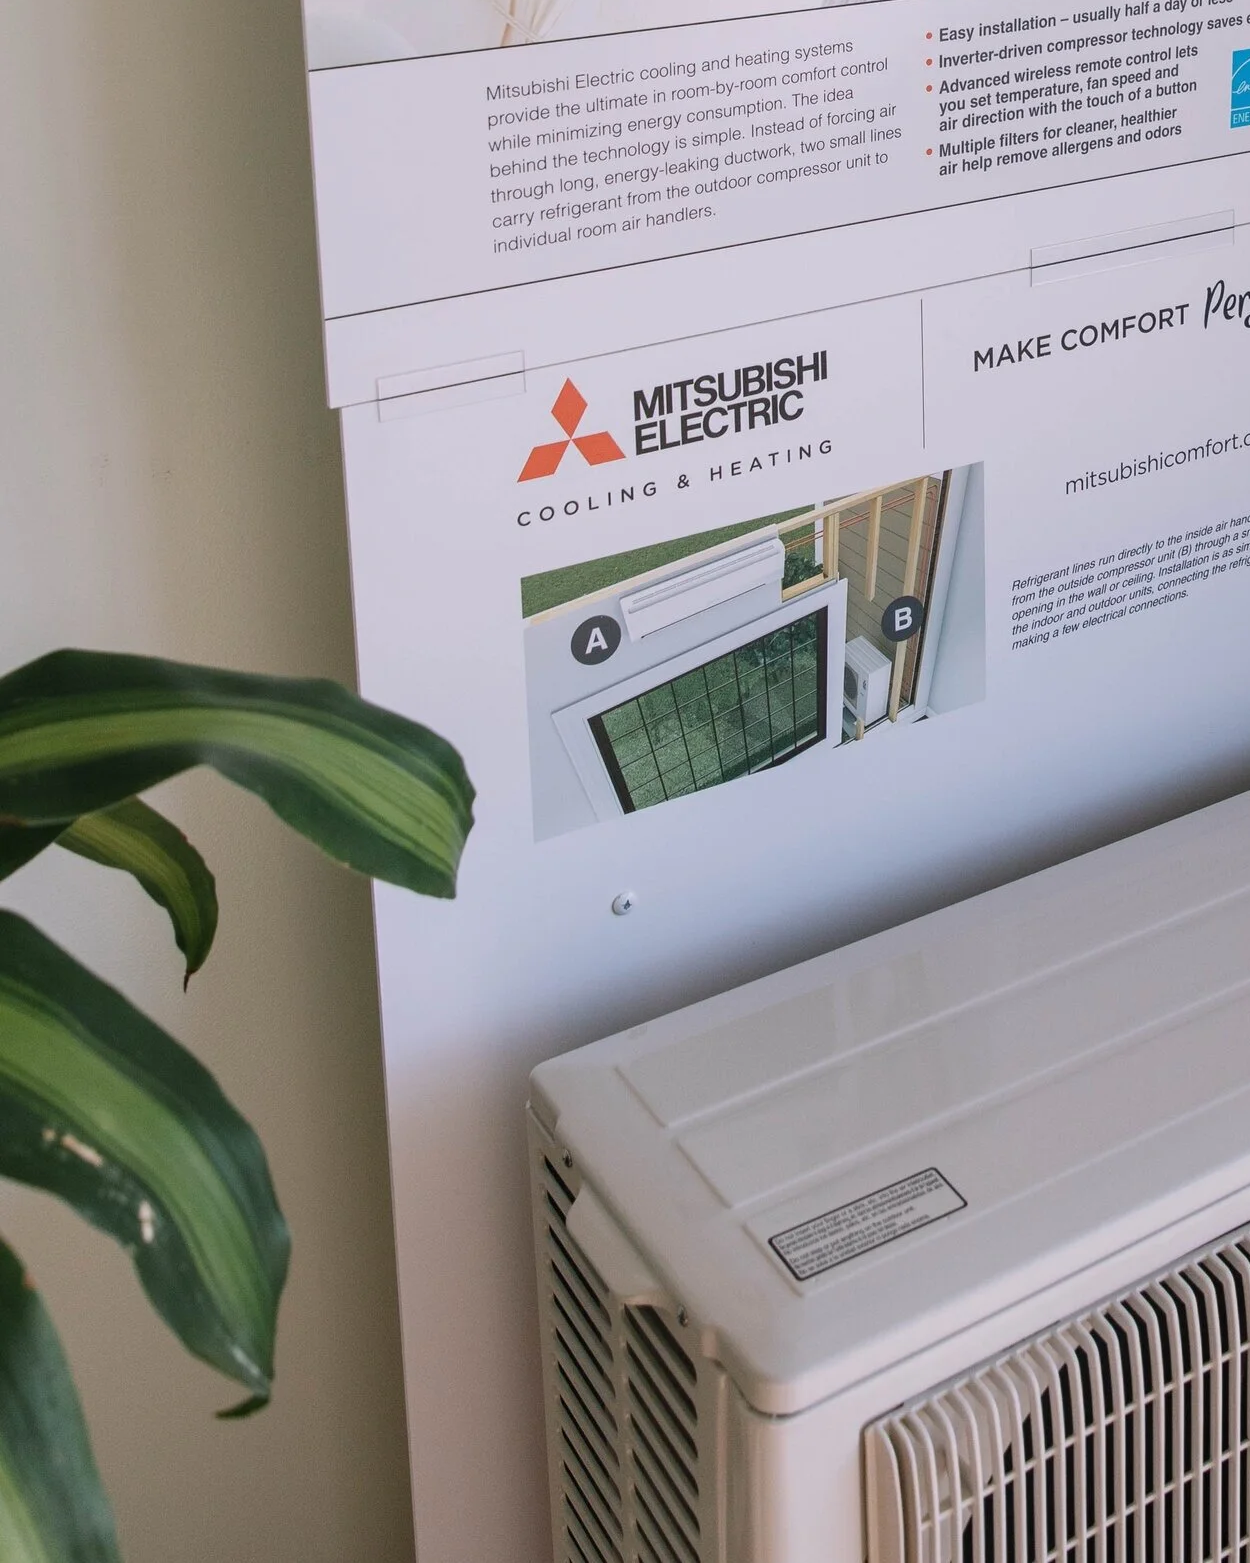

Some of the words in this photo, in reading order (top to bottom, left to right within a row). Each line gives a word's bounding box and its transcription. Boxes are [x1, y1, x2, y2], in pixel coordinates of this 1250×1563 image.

[939, 27, 975, 42] Easy
[979, 15, 1057, 37] installation
[1073, 5, 1121, 24] usually
[1125, 0, 1150, 17] half
[1152, 2, 1161, 13] a
[939, 44, 1043, 69] Inverter-driven
[1047, 31, 1128, 53] compressor
[1131, 21, 1204, 41] technology
[1207, 15, 1243, 30] saves
[486, 76, 570, 101] Mitsubishi
[575, 68, 635, 90] Electric
[639, 61, 696, 81] cooling
[701, 54, 730, 73] and
[735, 49, 790, 68] heating
[794, 39, 854, 62] systems
[939, 70, 1010, 95] Advanced
[1014, 65, 1072, 83] wireless
[1075, 56, 1122, 74] remote
[1125, 46, 1172, 67] control
[1175, 44, 1199, 59] lets
[939, 99, 966, 117] you
[970, 93, 992, 109] set
[995, 82, 1083, 105] temperature,
[1086, 76, 1108, 91] fan
[1111, 67, 1151, 89] speed
[1154, 63, 1179, 80] and
[939, 116, 959, 132] air
[962, 108, 1024, 128] direction
[1028, 101, 1057, 117] with
[1061, 98, 1083, 112] the
[1086, 90, 1124, 108] touch
[1128, 86, 1142, 102] of
[1144, 88, 1152, 99] a
[1156, 81, 1197, 97] button
[939, 136, 996, 158] Multiple
[999, 131, 1039, 148] filters
[1042, 126, 1062, 141] for
[1065, 118, 1117, 137] cleaner,
[1120, 107, 1178, 128] healthier
[489, 155, 547, 178] behind
[552, 153, 578, 169] the
[582, 140, 670, 164] technology
[675, 135, 687, 150] is
[692, 127, 745, 147] simple.
[751, 116, 805, 138] Instead
[809, 113, 823, 129] of
[826, 108, 875, 127] forcing
[879, 103, 897, 118] air
[939, 160, 959, 176] air
[962, 155, 993, 173] help
[997, 148, 1048, 166] remove
[1051, 136, 1114, 157] allergens
[1117, 128, 1142, 146] and
[1145, 125, 1182, 141] odors
[492, 211, 535, 229] carry
[540, 194, 623, 221] refrigerant
[626, 190, 662, 206] from
[666, 184, 690, 200] the
[694, 175, 752, 195] outdoor
[756, 160, 842, 185] compressor
[846, 153, 872, 170] unit
[874, 152, 889, 165] to
[493, 226, 572, 254] individual
[577, 222, 617, 239] room
[621, 215, 641, 232] air
[646, 206, 716, 228] handlers.
[974, 334, 1051, 372] MAKE
[1061, 303, 1189, 351] COMFORT
[634, 350, 828, 422] MITSUBISHI
[635, 390, 804, 456] ELECTRIC
[517, 482, 656, 526] COOLING
[677, 474, 690, 489] &
[710, 440, 832, 482] HEATING
[1011, 566, 1070, 592] Refrigerant
[1072, 560, 1096, 574] lines
[1098, 554, 1115, 567] run
[1117, 542, 1154, 561] directly
[1155, 540, 1165, 550] to
[1167, 534, 1183, 547] the
[1184, 525, 1214, 542] inside
[1215, 520, 1229, 533] air
[585, 626, 609, 655] A
[894, 606, 913, 632] B
